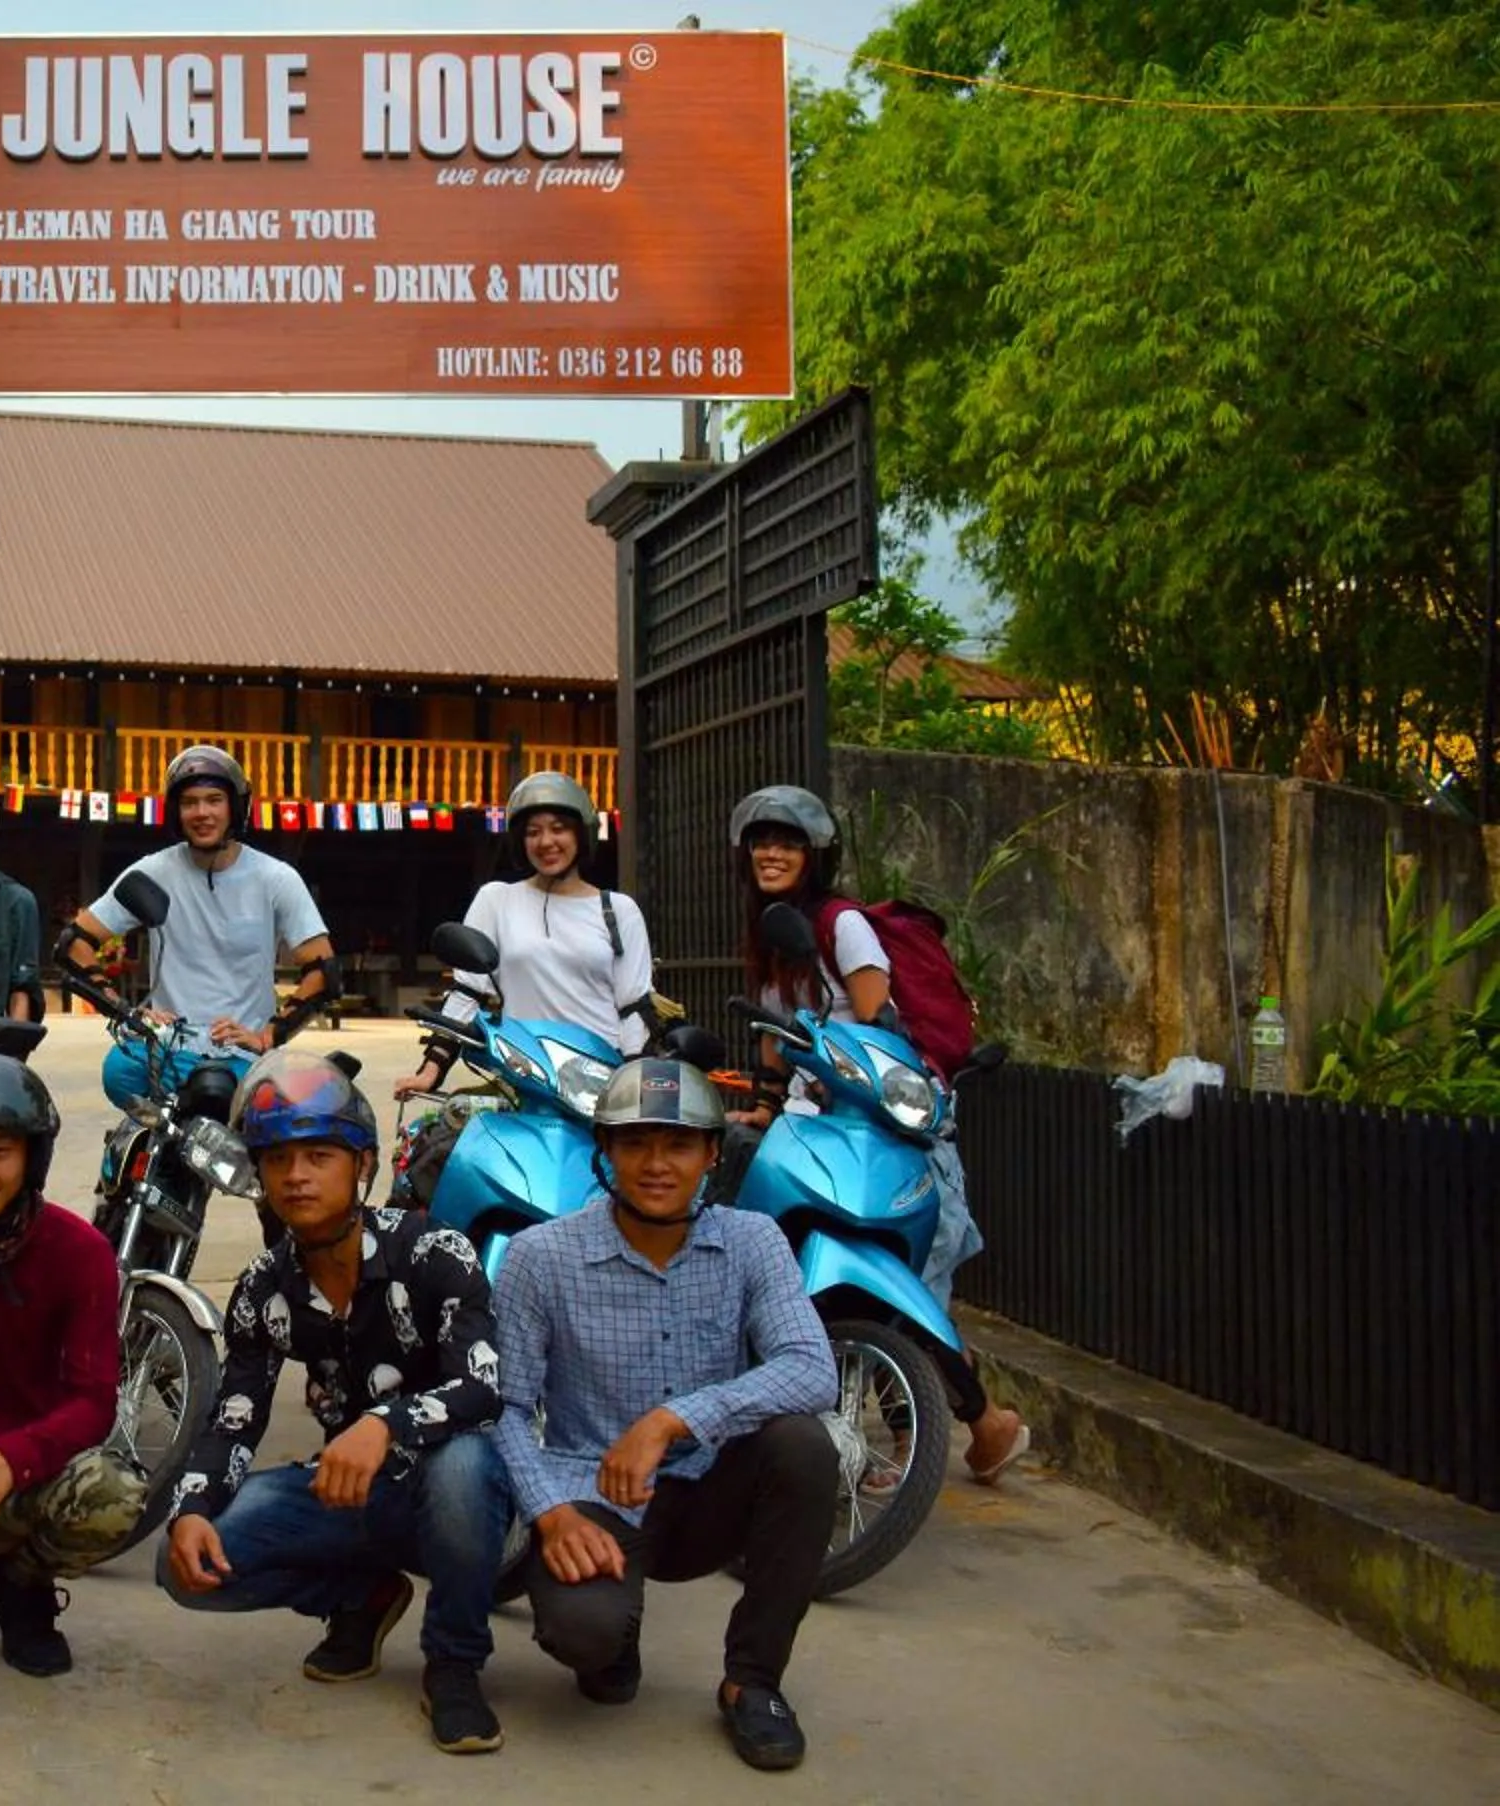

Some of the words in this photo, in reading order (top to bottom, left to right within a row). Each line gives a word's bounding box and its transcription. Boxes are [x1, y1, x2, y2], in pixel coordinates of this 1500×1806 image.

[0, 52, 311, 160] JUNGLE
[361, 50, 623, 158] HOUSE
[436, 166, 478, 187] we
[482, 166, 530, 187] are
[534, 160, 625, 192] family
[123, 208, 169, 241] HA
[180, 208, 282, 241] GIANG
[289, 208, 377, 240] TOUR
[124, 264, 345, 304] INFORMATION
[373, 263, 478, 303] DRINK
[485, 263, 510, 303] &
[518, 263, 619, 303] MUSIC
[436, 346, 549, 378] HOTLINE:
[558, 346, 607, 378] 036
[614, 346, 662, 378] 212
[671, 346, 703, 378] 66
[712, 346, 743, 378] 88
